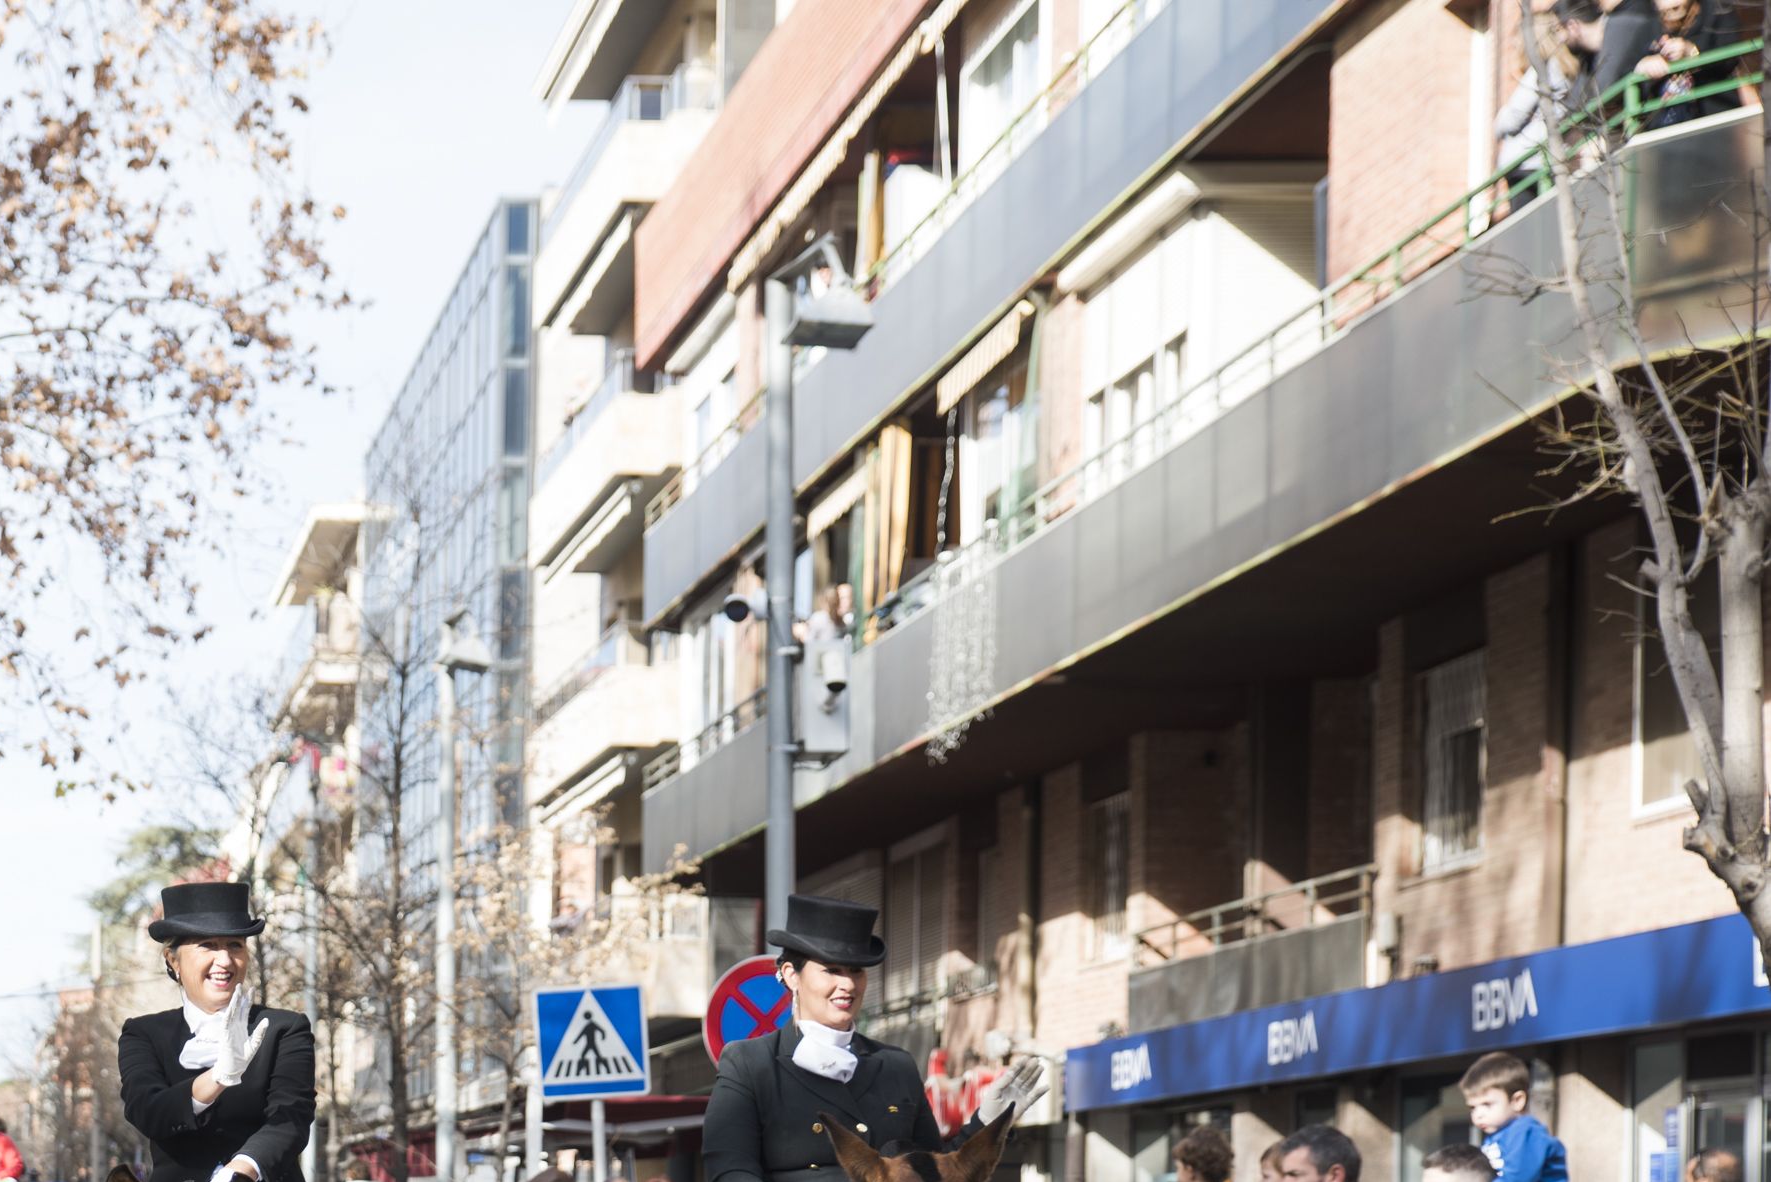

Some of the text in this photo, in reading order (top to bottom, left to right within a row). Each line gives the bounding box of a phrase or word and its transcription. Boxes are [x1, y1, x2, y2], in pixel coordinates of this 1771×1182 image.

[1472, 968, 1538, 1031] BBVA
[1268, 1009, 1318, 1066] BBVA
[1111, 1043, 1152, 1091] BBVA
